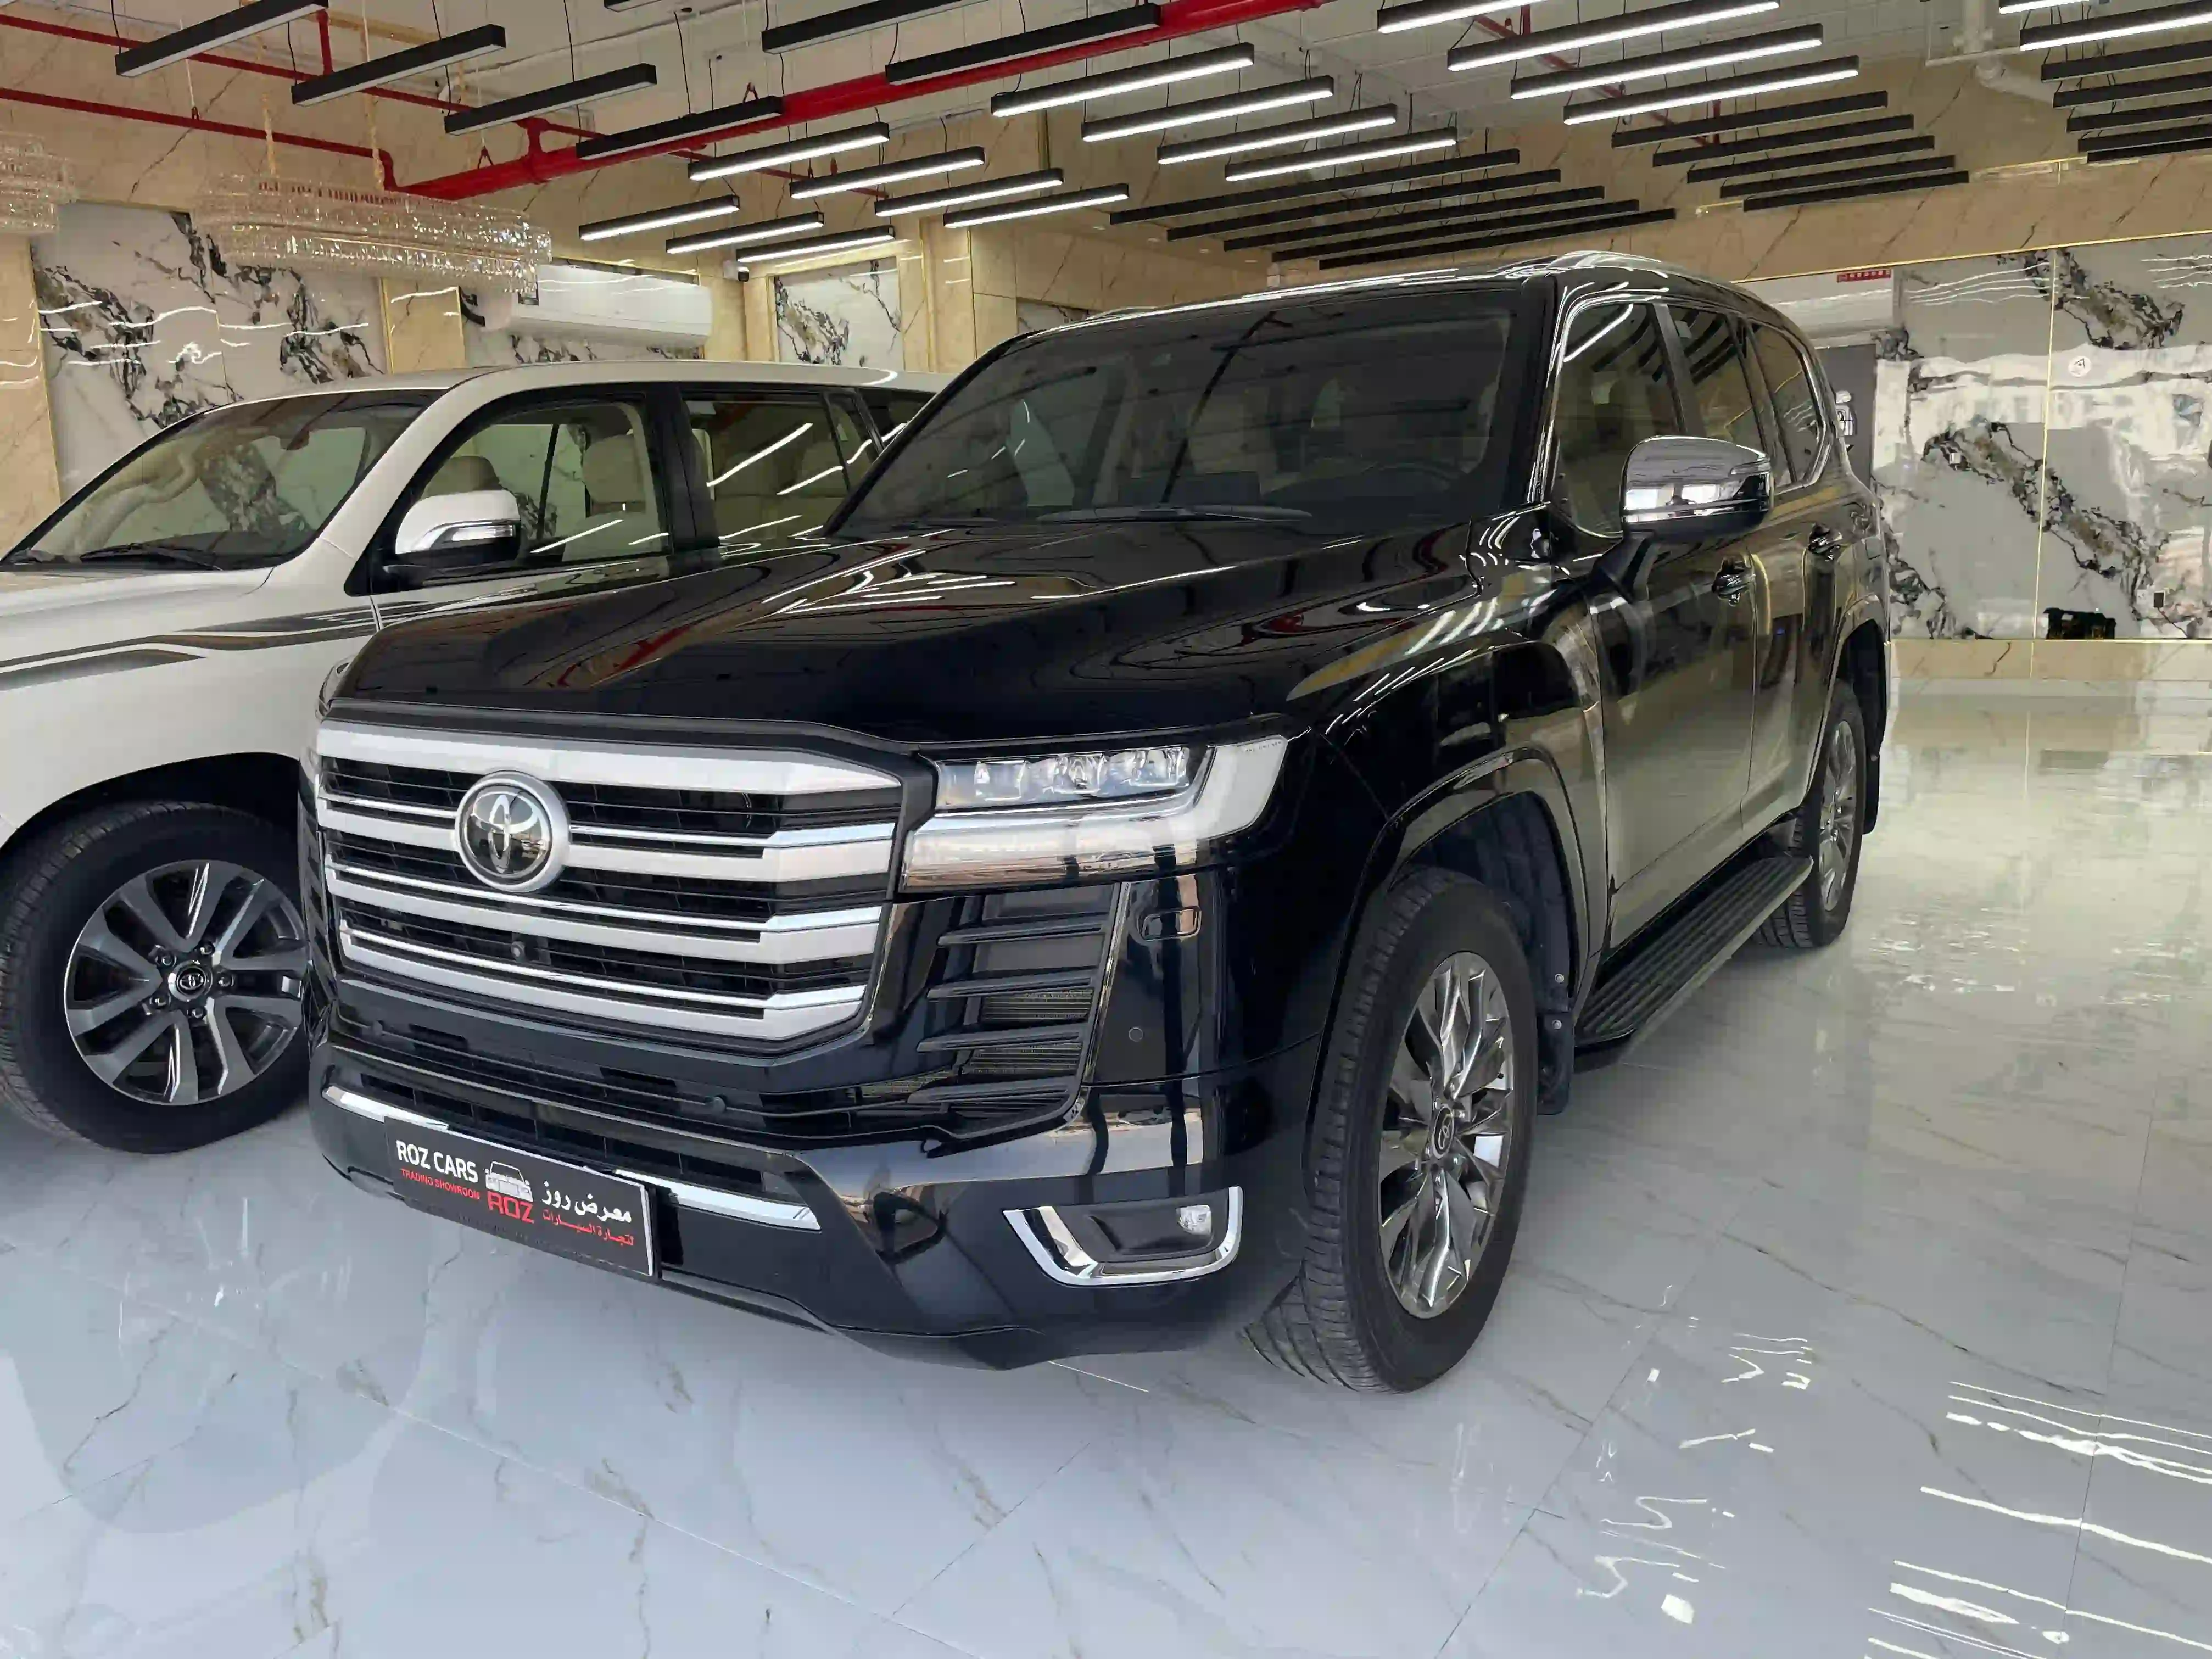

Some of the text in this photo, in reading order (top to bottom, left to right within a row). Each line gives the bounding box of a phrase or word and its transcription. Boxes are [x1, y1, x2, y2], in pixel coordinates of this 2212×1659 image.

[396, 1140, 478, 1183] ROZ CARS
[400, 1168, 480, 1200] TRADING SHOWROOM
[541, 1181, 632, 1223] معرض روز
[487, 1191, 534, 1224] ROZ
